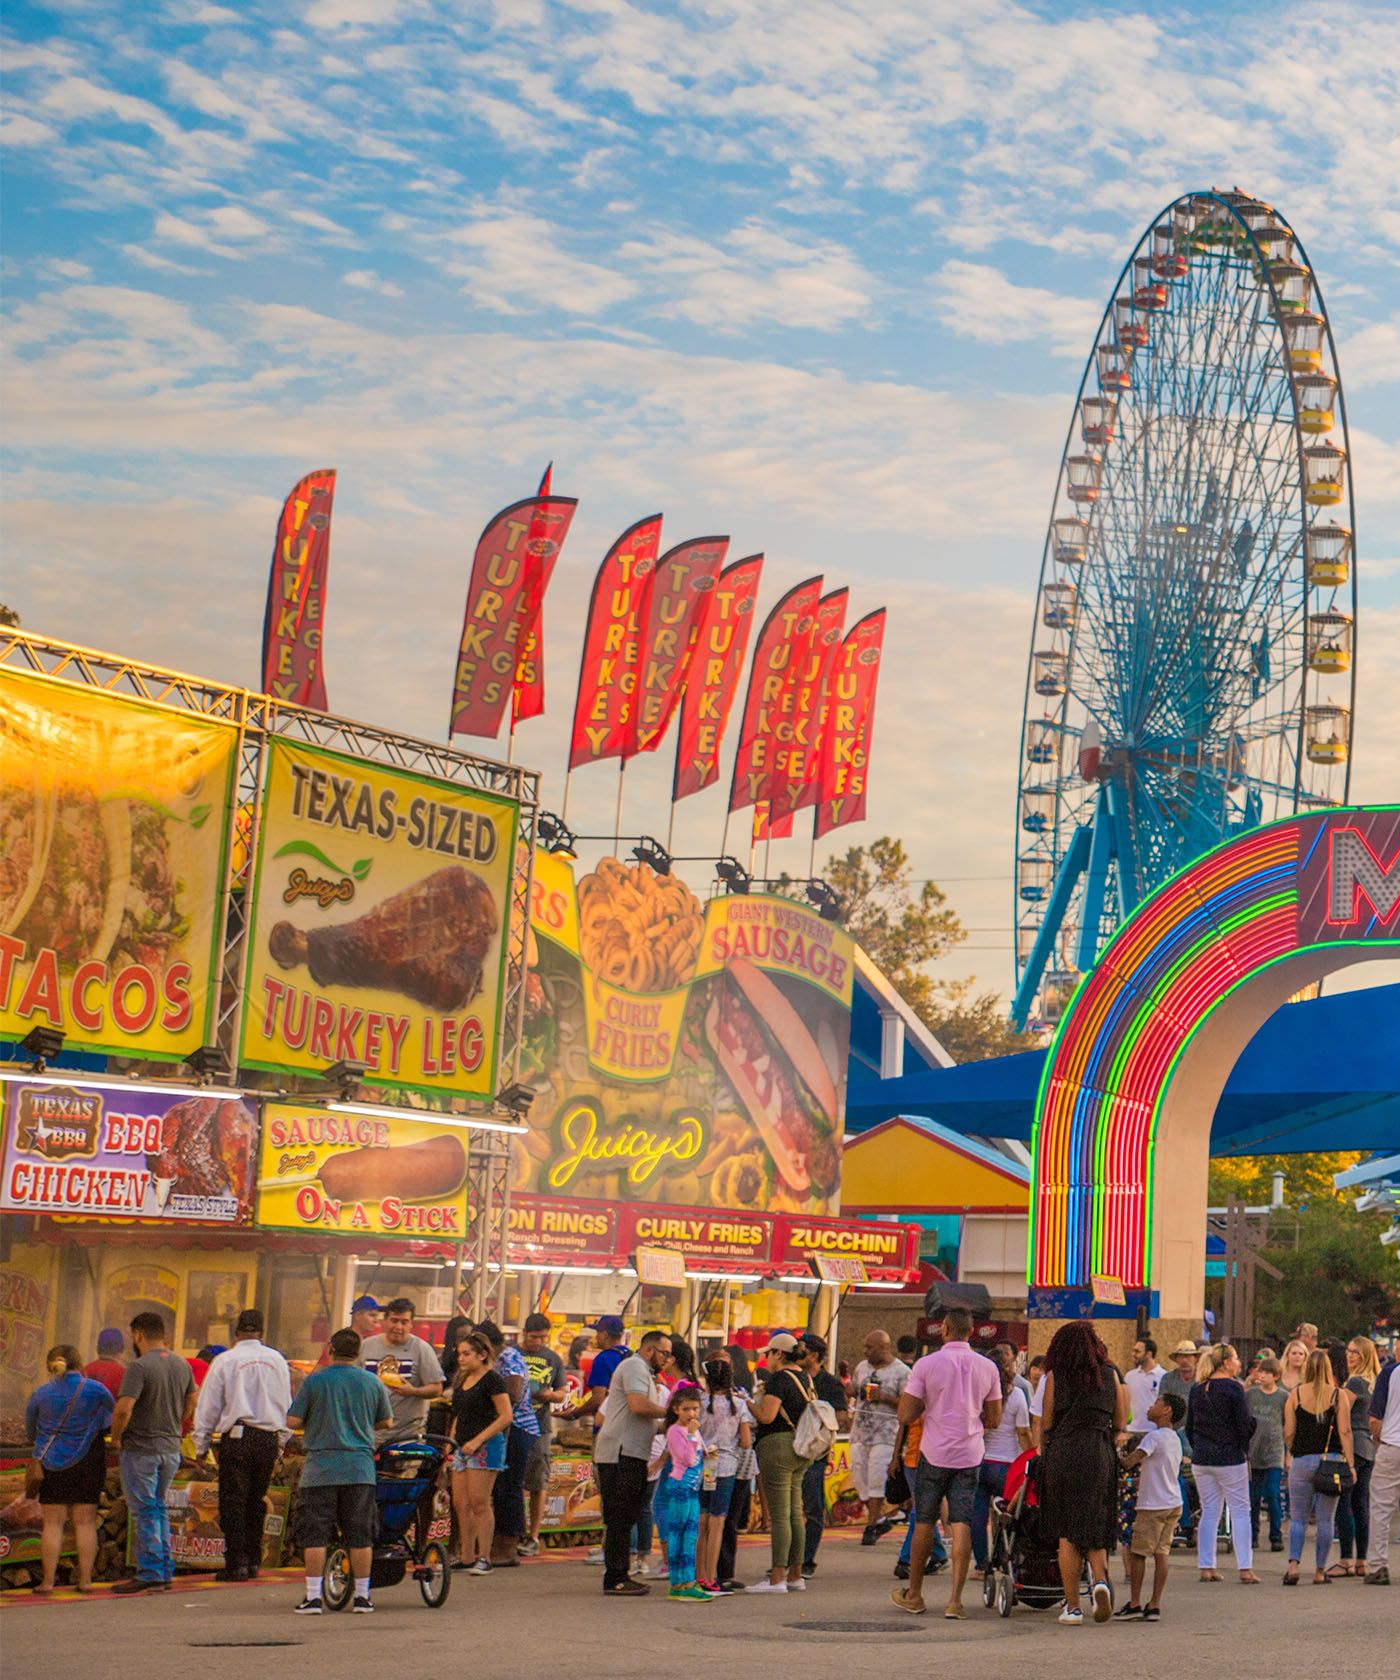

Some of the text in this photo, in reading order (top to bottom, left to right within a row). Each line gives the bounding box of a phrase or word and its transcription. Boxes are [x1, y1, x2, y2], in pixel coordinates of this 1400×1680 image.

[273, 499, 309, 701] TURKEY
[453, 519, 529, 720] TURKEY
[483, 590, 529, 704] LEGS
[585, 554, 635, 757] TURKEY
[618, 611, 640, 725] LEGS
[637, 562, 690, 751] TURKEY
[692, 591, 735, 787] TURKEY
[747, 612, 798, 801] TURKEY
[829, 643, 859, 825] TURKEY
[291, 763, 498, 864] TEXAS-SIZED
[711, 924, 848, 993] SAUSAGE
[728, 902, 835, 945] GIANT WESTERN
[0, 934, 193, 1033] TACOS
[262, 976, 484, 1075] TURKEY LEG
[605, 995, 663, 1031] CURLY
[592, 1020, 673, 1068] FRIES
[31, 1095, 94, 1121] TEXAS
[50, 1127, 88, 1148] BBQ
[105, 1112, 163, 1155] BBQ
[271, 1117, 389, 1148] SAUSAGE
[10, 1162, 150, 1211] CHICKEN
[541, 1211, 609, 1236] RINGS
[635, 1217, 763, 1245] CURLY FRIES
[789, 1227, 898, 1254] ZUCCHINI
